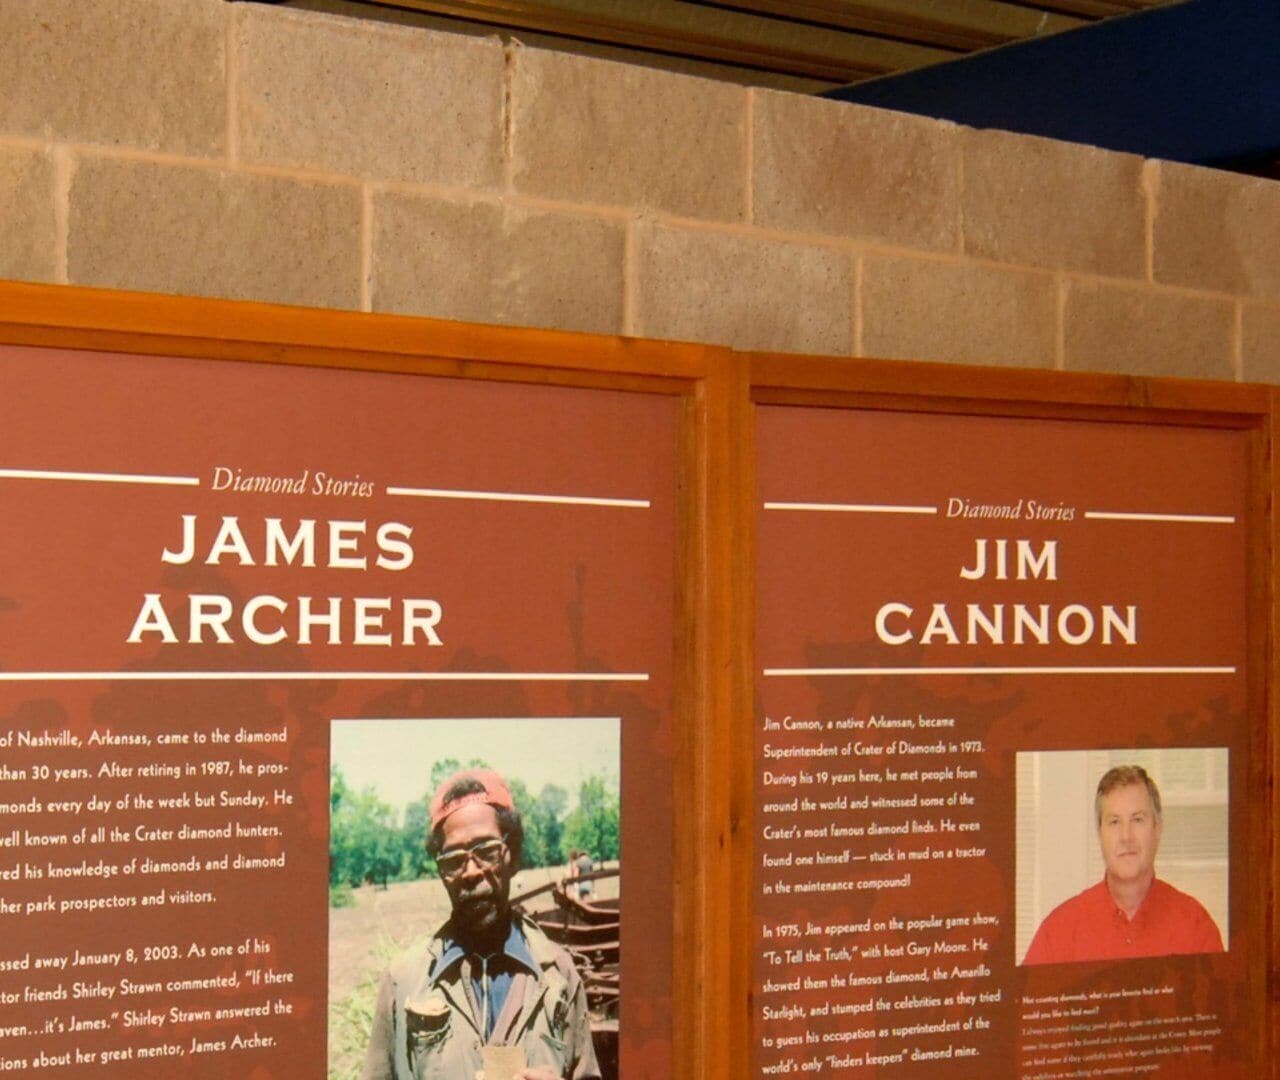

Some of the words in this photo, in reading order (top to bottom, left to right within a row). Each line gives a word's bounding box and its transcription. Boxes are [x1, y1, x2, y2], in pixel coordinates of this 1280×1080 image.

[212, 467, 307, 494] Diamond
[312, 472, 374, 497] Stories
[947, 498, 1021, 519] Diamond
[1025, 500, 1075, 520] Stories
[162, 515, 413, 570] JAMES
[960, 539, 1056, 580] JIM
[127, 594, 443, 646] ARCHER
[876, 603, 1136, 644] CANNON
[763, 716, 781, 731] Jim
[783, 715, 823, 731] Cannon,
[827, 720, 833, 729] a
[836, 717, 865, 729] native
[867, 714, 915, 729] Arkansan,
[919, 713, 955, 728] became
[17, 729, 82, 748] Nashville,
[87, 728, 151, 746] Arkansas,
[156, 734, 189, 744] came
[192, 731, 207, 744] to
[210, 727, 231, 743] the
[234, 726, 287, 743] diamond
[763, 742, 838, 760] Superintendent
[841, 741, 852, 755] of
[854, 741, 884, 755] Crater
[886, 740, 897, 755] of
[899, 739, 946, 754] Diamonds
[949, 741, 958, 752] in
[960, 740, 985, 752] 1973.
[31, 764, 50, 780] 30
[53, 768, 92, 782] years.
[97, 761, 133, 778] After
[137, 763, 181, 779] retiring
[184, 762, 196, 775] in
[200, 760, 234, 776] 1987,
[238, 758, 253, 774] he
[257, 763, 288, 777] pros-
[763, 770, 797, 787] During
[799, 770, 813, 784] his
[816, 771, 829, 783] 19
[831, 773, 856, 785] years
[859, 768, 883, 783] here,
[886, 767, 898, 781] he
[900, 769, 918, 781] met
[921, 766, 954, 782] people
[956, 765, 978, 779] from
[46, 801, 83, 814] every
[86, 794, 112, 813] day
[115, 793, 130, 810] of
[133, 793, 154, 809] the
[157, 791, 190, 808] week
[194, 791, 215, 807] but
[219, 789, 269, 808] Sunday.
[273, 788, 293, 804] He
[763, 797, 798, 813] around
[801, 797, 817, 811] the
[819, 795, 847, 810] world
[850, 794, 869, 809] and
[871, 793, 917, 808] witnessed
[920, 797, 944, 807] some
[947, 791, 958, 806] of
[959, 791, 975, 805] the
